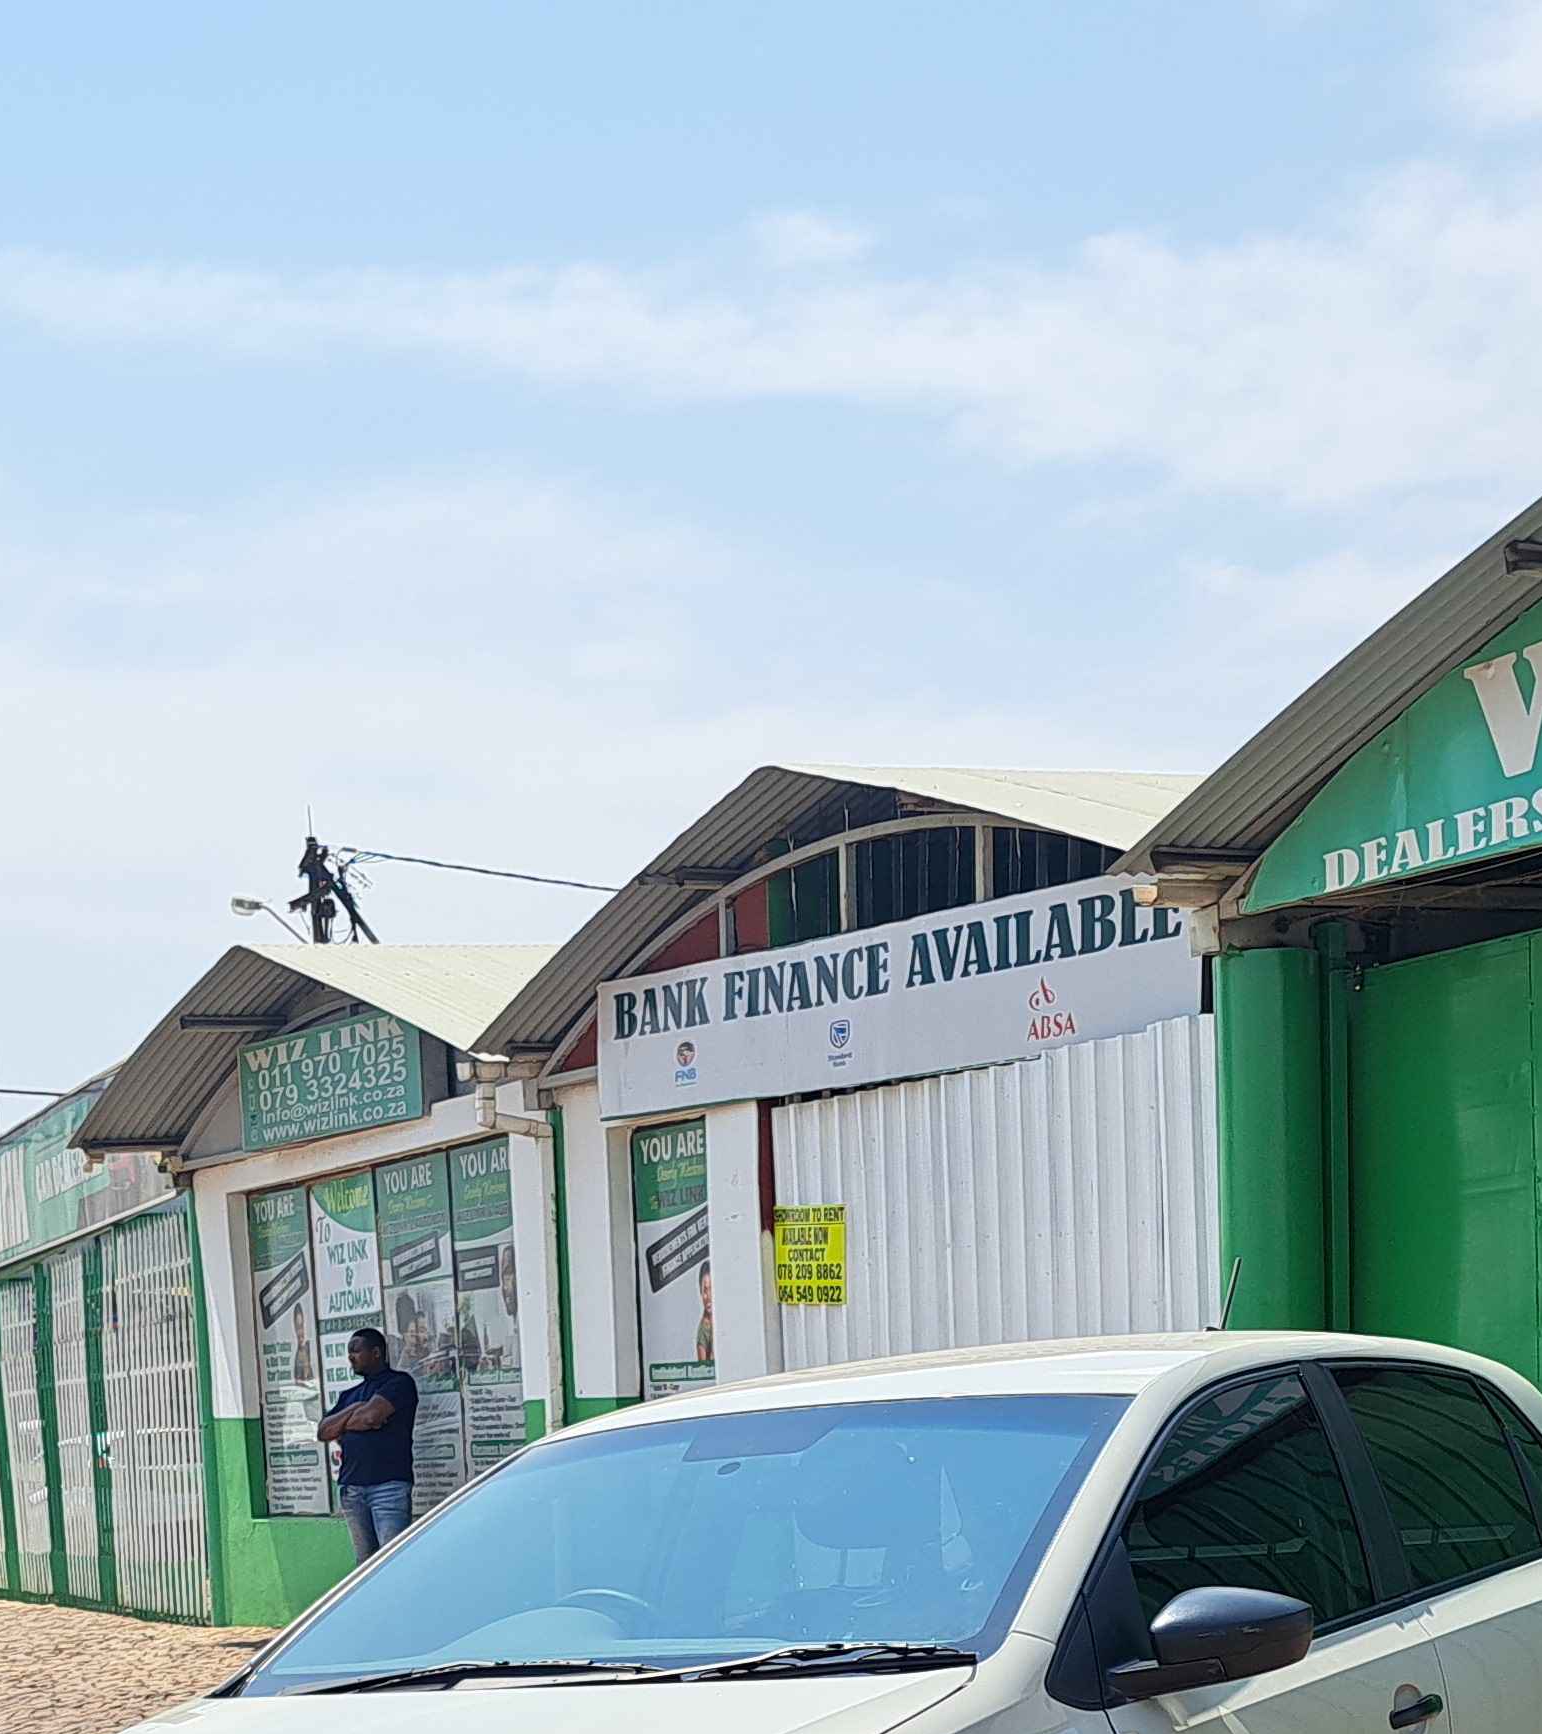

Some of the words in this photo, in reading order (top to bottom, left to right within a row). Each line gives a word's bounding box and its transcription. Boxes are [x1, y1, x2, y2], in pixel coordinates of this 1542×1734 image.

[614, 976, 711, 1041] BANK
[723, 941, 891, 1023] FINANCE
[905, 888, 1184, 990] AVAILABLE
[1027, 1013, 1076, 1042] ABSA
[244, 1038, 307, 1072] WIZ
[319, 1015, 404, 1054] LINK
[259, 1064, 292, 1090] 011
[301, 1052, 341, 1080] 970
[348, 1036, 405, 1069] 7025
[675, 1068, 697, 1083] FNB
[259, 1084, 298, 1111] 079
[306, 1059, 407, 1101] 3324325
[262, 1100, 407, 1142] www.wizlink.co.za
[640, 1135, 671, 1164] YOU
[676, 1129, 703, 1158] ARE
[460, 1152, 486, 1179] YOU
[491, 1147, 507, 1173] AR
[384, 1168, 407, 1195] YOU
[411, 1163, 432, 1189] ARE
[253, 1199, 275, 1225] YOU
[277, 1195, 295, 1219] ARE
[324, 1180, 370, 1215] Welcome
[812, 1208, 821, 1222] TO
[824, 1207, 844, 1222] RENT
[316, 1216, 331, 1244] To
[327, 1245, 347, 1264] WIZ
[788, 1248, 826, 1262] CONTACT
[778, 1264, 792, 1280] 078
[796, 1264, 812, 1280] 209
[816, 1263, 842, 1280] 8862
[329, 1286, 374, 1313] AUTOMAX
[797, 1285, 813, 1301] 549
[817, 1285, 842, 1302] 0922
